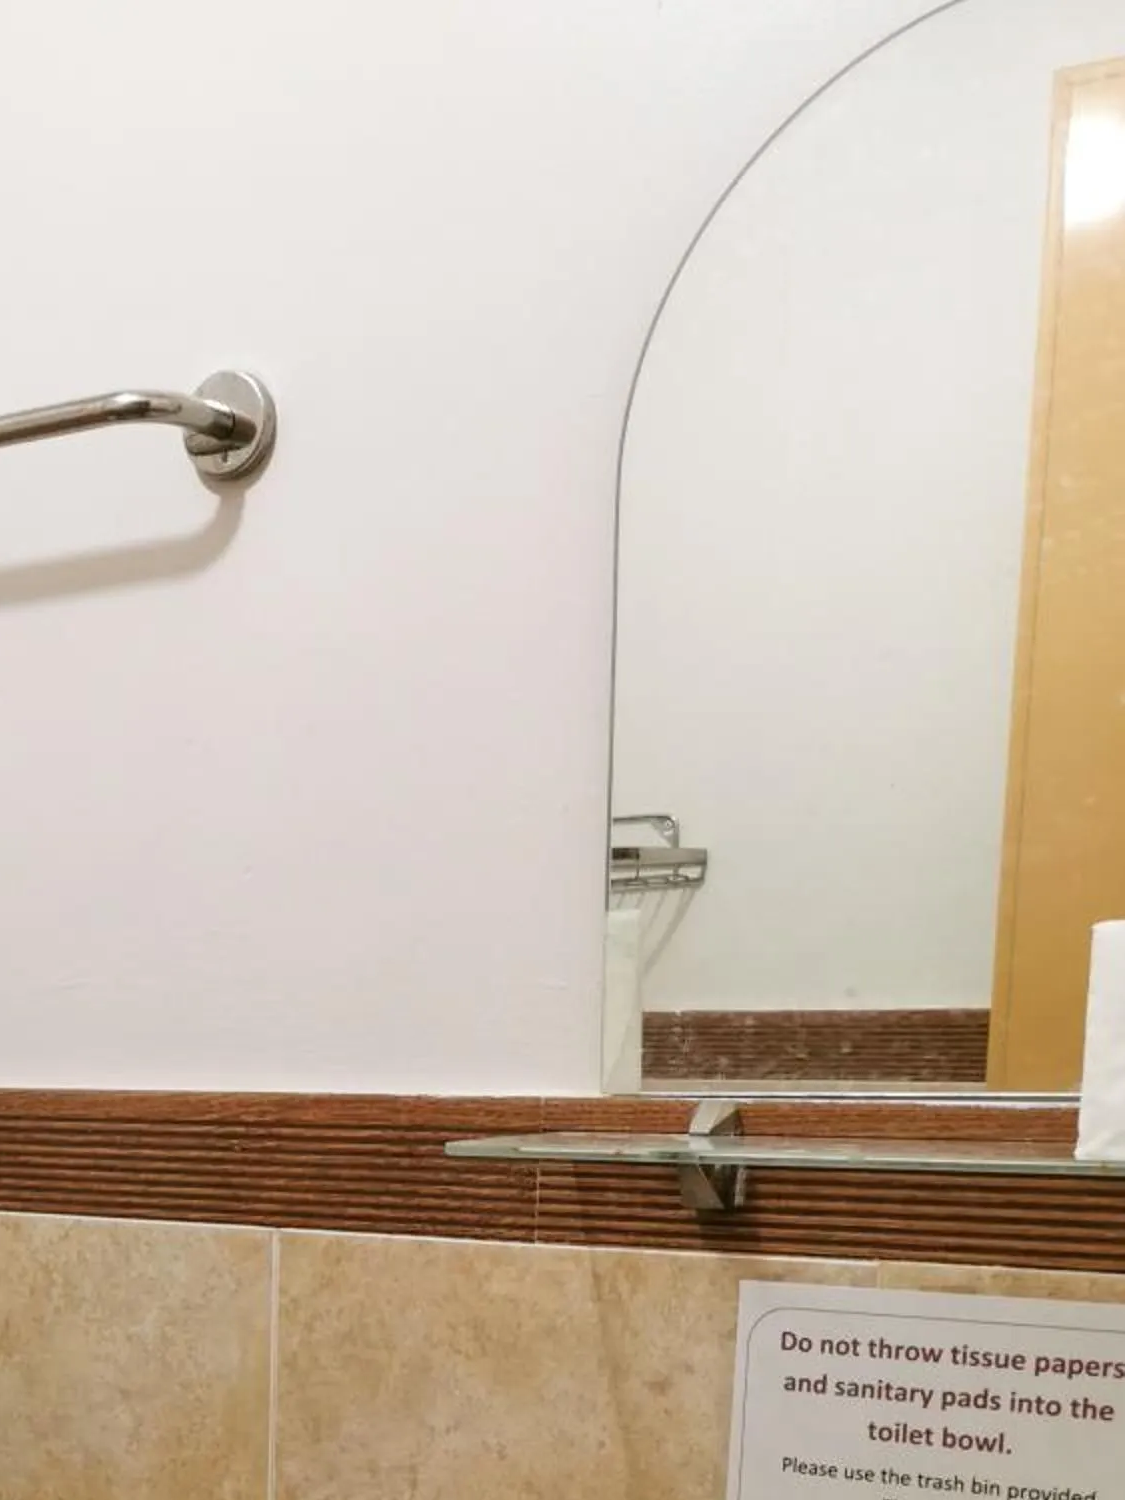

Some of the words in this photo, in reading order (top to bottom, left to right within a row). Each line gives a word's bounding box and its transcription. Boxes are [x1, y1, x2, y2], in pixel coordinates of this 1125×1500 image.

[781, 1331, 813, 1353] Do
[820, 1337, 860, 1357] not
[868, 1336, 943, 1363] throw
[951, 1344, 1027, 1371] tissue
[1034, 1355, 1125, 1380] papers
[783, 1373, 828, 1395] and
[835, 1379, 934, 1409] sanitary
[940, 1388, 1001, 1412] pads
[1010, 1391, 1062, 1417] into
[1070, 1397, 1115, 1421] the
[868, 1421, 934, 1447] toilet
[941, 1426, 1012, 1455] bowl.
[782, 1456, 838, 1478] Please
[844, 1467, 876, 1483] use
[881, 1467, 912, 1487] the
[917, 1473, 965, 1493] trash
[971, 1475, 1001, 1497] bin
